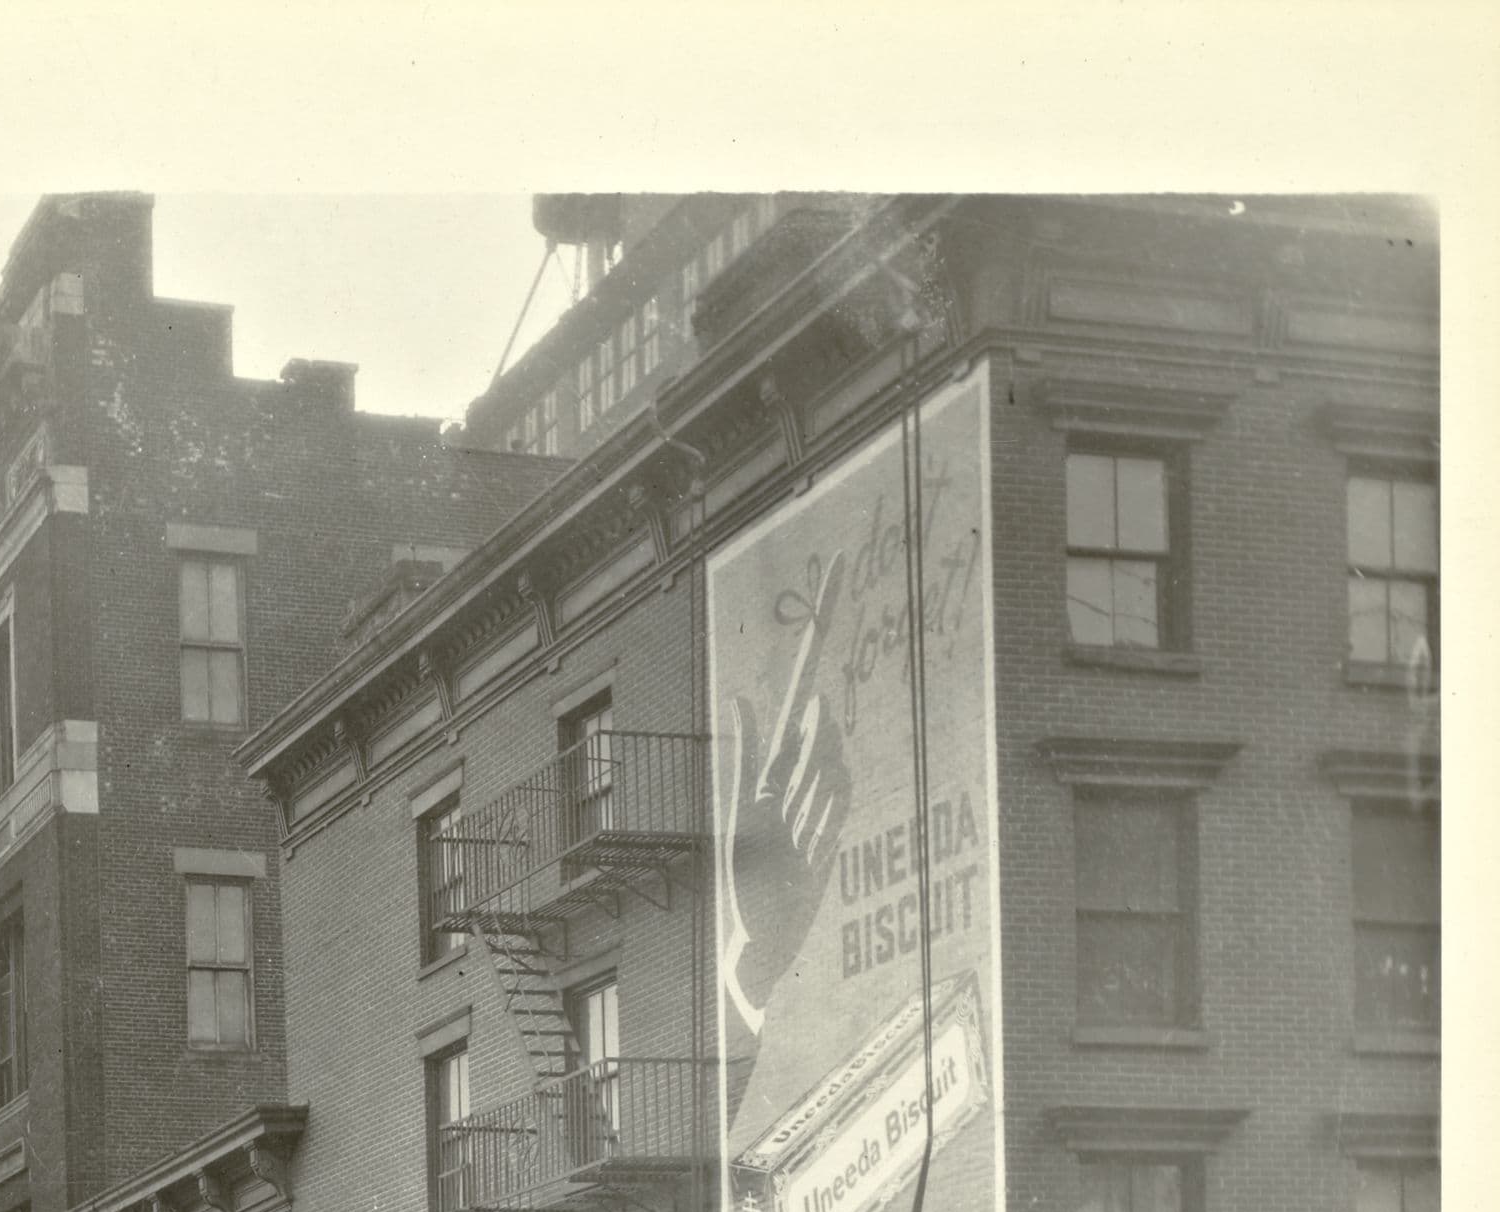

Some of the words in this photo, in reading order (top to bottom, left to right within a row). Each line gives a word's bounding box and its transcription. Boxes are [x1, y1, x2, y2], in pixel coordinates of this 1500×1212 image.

[842, 864, 978, 979] BISCUIT
[772, 1072, 853, 1142] Uneeda
[885, 1055, 959, 1147] Biscuit
